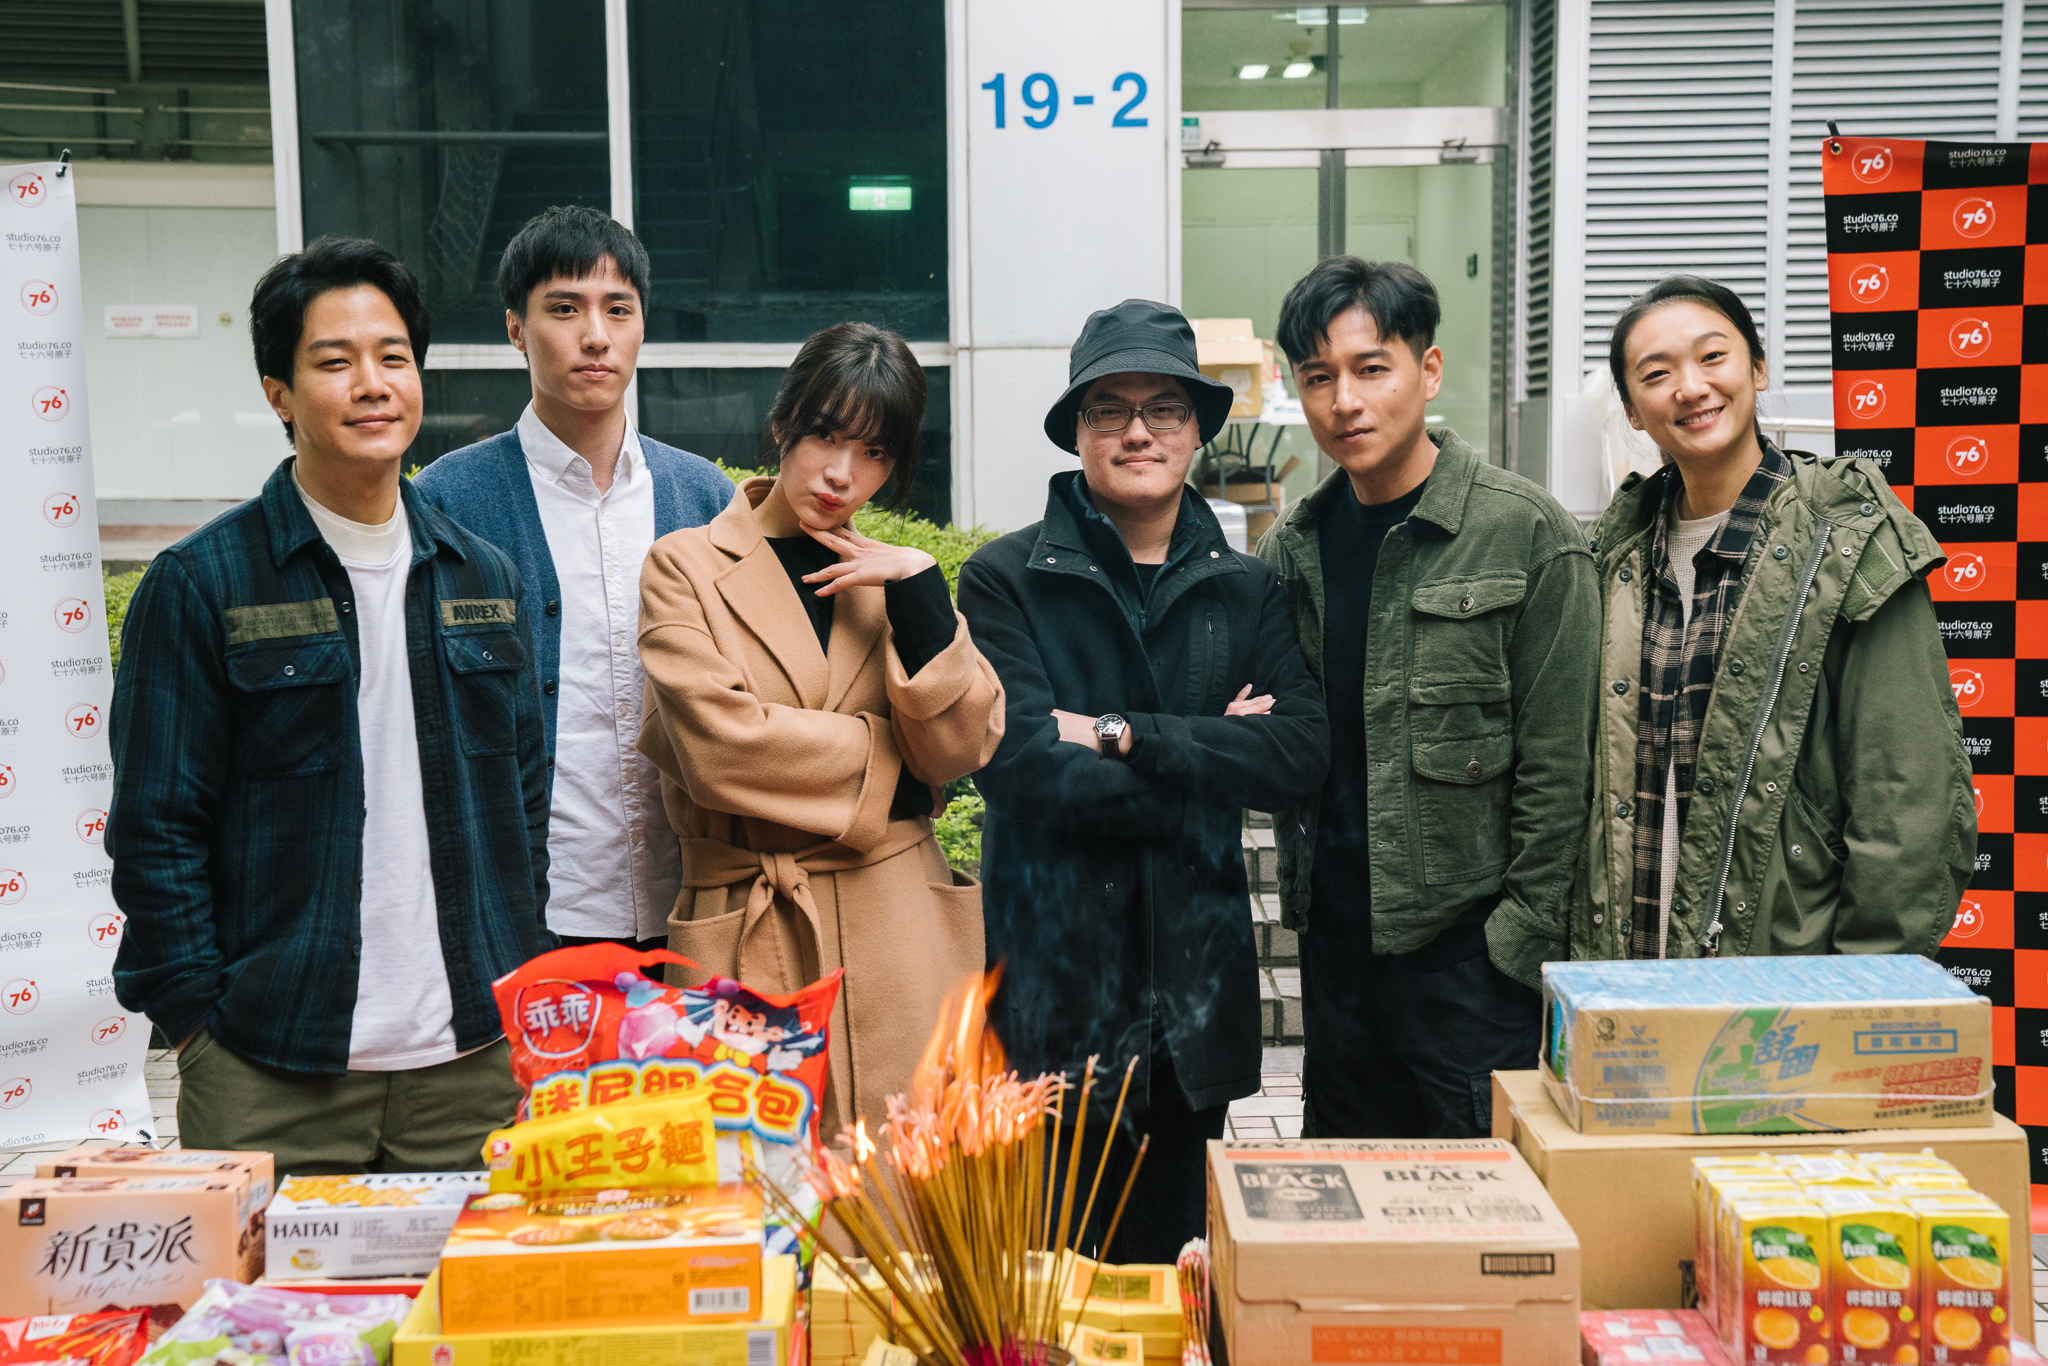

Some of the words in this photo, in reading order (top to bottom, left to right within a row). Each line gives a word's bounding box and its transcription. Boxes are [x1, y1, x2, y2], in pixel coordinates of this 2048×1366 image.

[981, 72, 1149, 130] 19-2
[1949, 149, 2007, 159] studio76.co
[1861, 154, 1885, 175] 76
[1949, 157, 2005, 168] 七十六号原子
[17, 182, 39, 199] 76
[1843, 213, 1899, 224] studio76.co
[1962, 208, 1987, 229] 76
[1844, 223, 1898, 233] 七十六号原子
[6, 232, 61, 243] studio76.co
[8, 242, 61, 252] 七十六号原子
[1944, 269, 2001, 280] studio76.co
[1857, 274, 1881, 294] 76
[1944, 279, 2000, 289] 七十六号原子
[29, 290, 51, 307] 76
[18, 341, 72, 350] studio76.co
[1843, 333, 1895, 343] studio76.co
[1958, 329, 1983, 349] 76
[19, 350, 72, 359] 七十六号原子
[1843, 342, 1894, 351] 七十六号原子
[1940, 386, 1997, 397] studio76.co
[40, 396, 62, 414] 76
[1856, 391, 1878, 410] 76
[1940, 396, 1997, 406] 七十六号原子
[29, 446, 82, 456] studio76.co
[1955, 446, 1980, 466] 76
[30, 454, 82, 465] 七十六号原子
[52, 502, 73, 520] 76
[1938, 505, 1995, 515] studio76.co
[1938, 514, 1994, 524] 七十六号原子
[40, 552, 92, 563] studio76.co
[41, 560, 93, 571] 七十六号原子
[1953, 563, 1978, 583] 76
[63, 608, 84, 625] 76
[453, 604, 500, 620] AVIREX
[1937, 620, 1993, 630] studio76.co
[51, 656, 103, 668] studio76.co
[52, 666, 103, 677] 七十六号原子
[74, 712, 95, 731] 76
[62, 763, 114, 775] studio76.co
[84, 818, 105, 837] 76
[96, 922, 118, 941] 76
[9, 988, 32, 1007] 76
[524, 993, 591, 1038] 乖乖
[100, 1023, 119, 1039] 76
[1753, 1024, 1820, 1081] 舒跑
[77, 1061, 128, 1079] studio76.co
[4, 1085, 25, 1103] 76
[514, 1120, 707, 1187] 小王子麵
[1241, 1173, 1345, 1189] BLACK
[1383, 1169, 1504, 1182] BLACK
[273, 1221, 339, 1238] HAITAI
[35, 1214, 202, 1281] 新貴派
